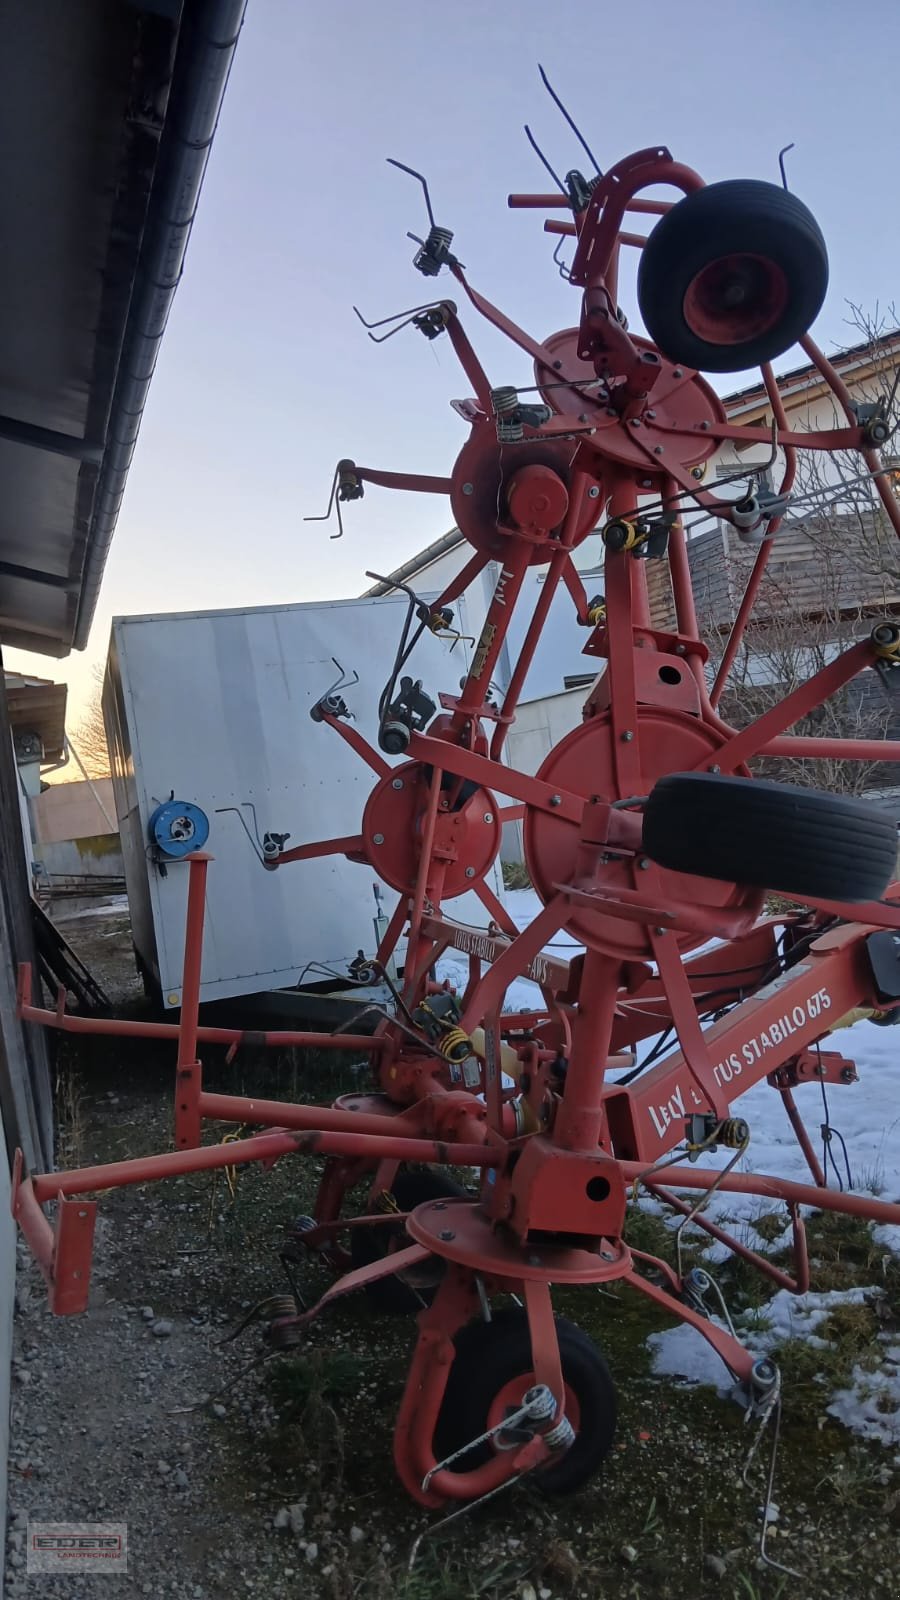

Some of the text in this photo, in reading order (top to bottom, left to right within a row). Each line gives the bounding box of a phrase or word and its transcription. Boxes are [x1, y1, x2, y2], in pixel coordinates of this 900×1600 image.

[648, 1084, 687, 1139] LELY
[741, 1006, 806, 1065] STABILO
[806, 987, 832, 1019] 675
